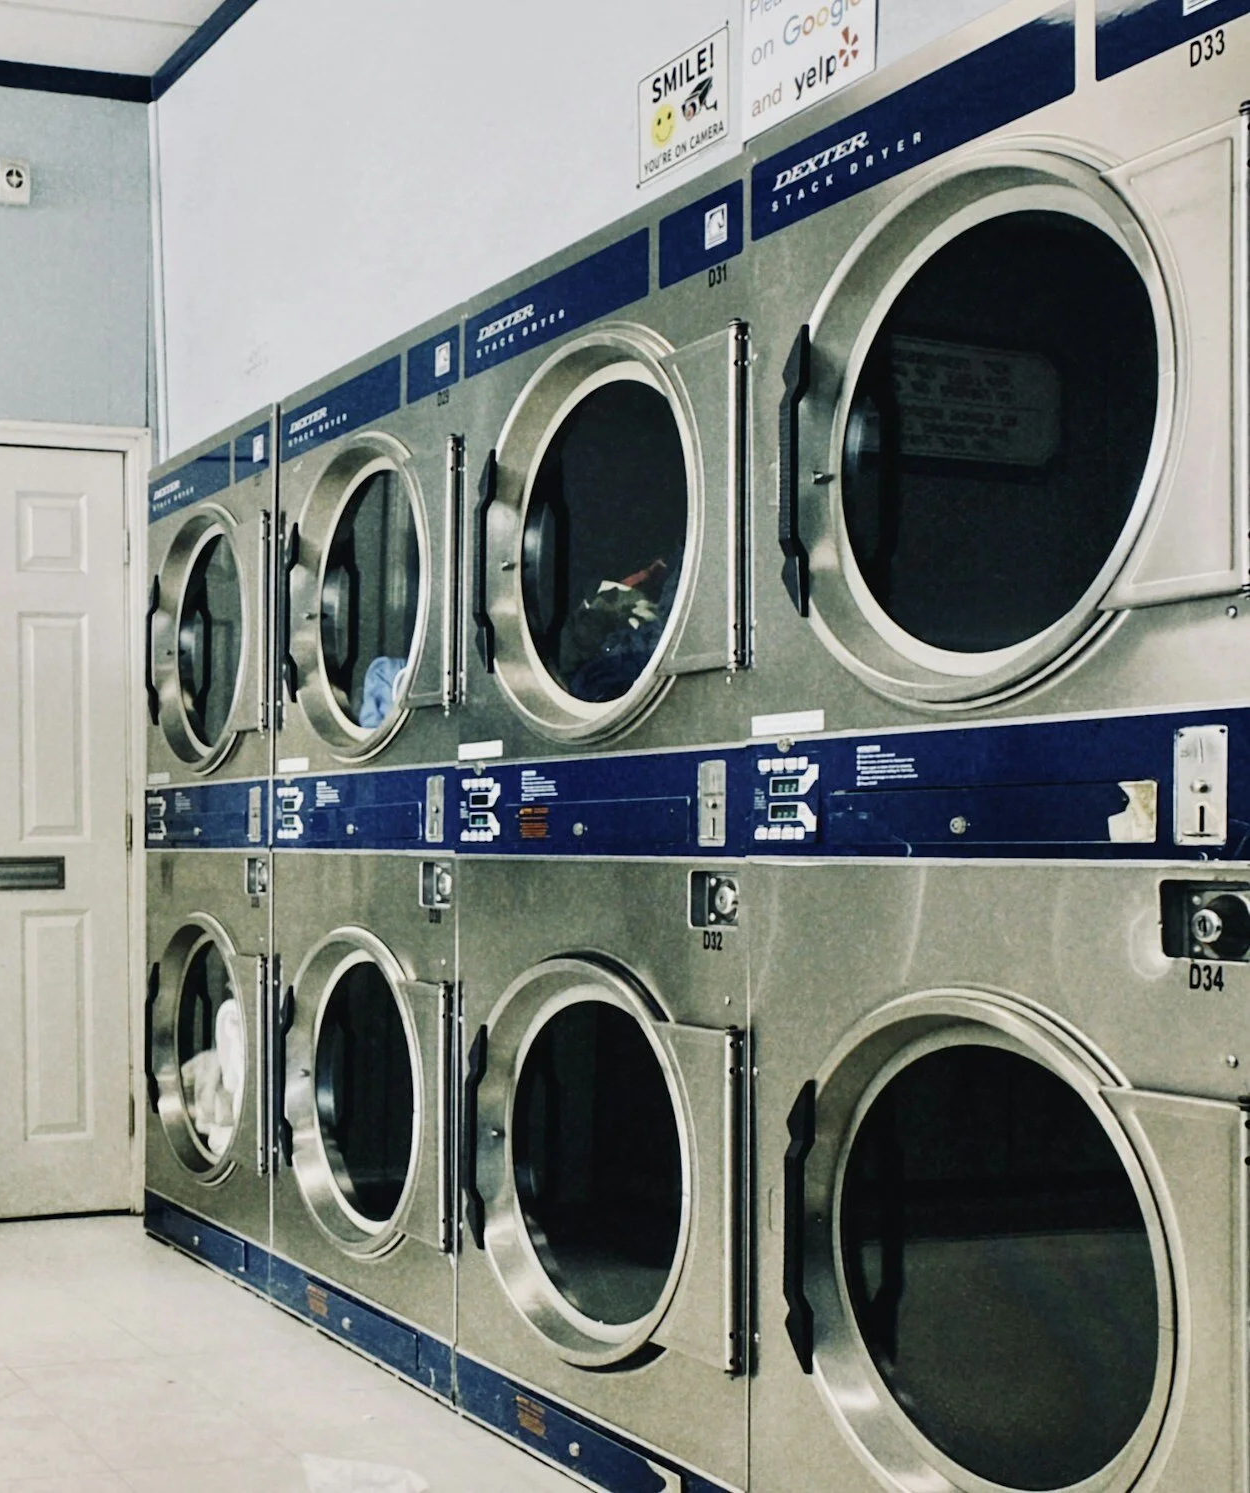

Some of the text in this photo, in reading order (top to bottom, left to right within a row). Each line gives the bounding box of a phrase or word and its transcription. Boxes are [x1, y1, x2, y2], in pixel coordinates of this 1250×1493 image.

[751, 39, 774, 65] on
[1190, 29, 1225, 68] D33
[652, 42, 714, 104] SMILE!
[751, 55, 837, 117] and yelp
[644, 120, 725, 175] YOU'RE ON CAMERA
[772, 131, 869, 192] DEXTER
[772, 131, 921, 212] STACK DRYER
[708, 263, 727, 288] D31
[476, 309, 565, 359] STACK DRYER
[477, 304, 535, 342] DEXTER
[289, 407, 327, 435] DEXTER
[703, 931, 723, 951] D32
[1189, 963, 1224, 992] D34
